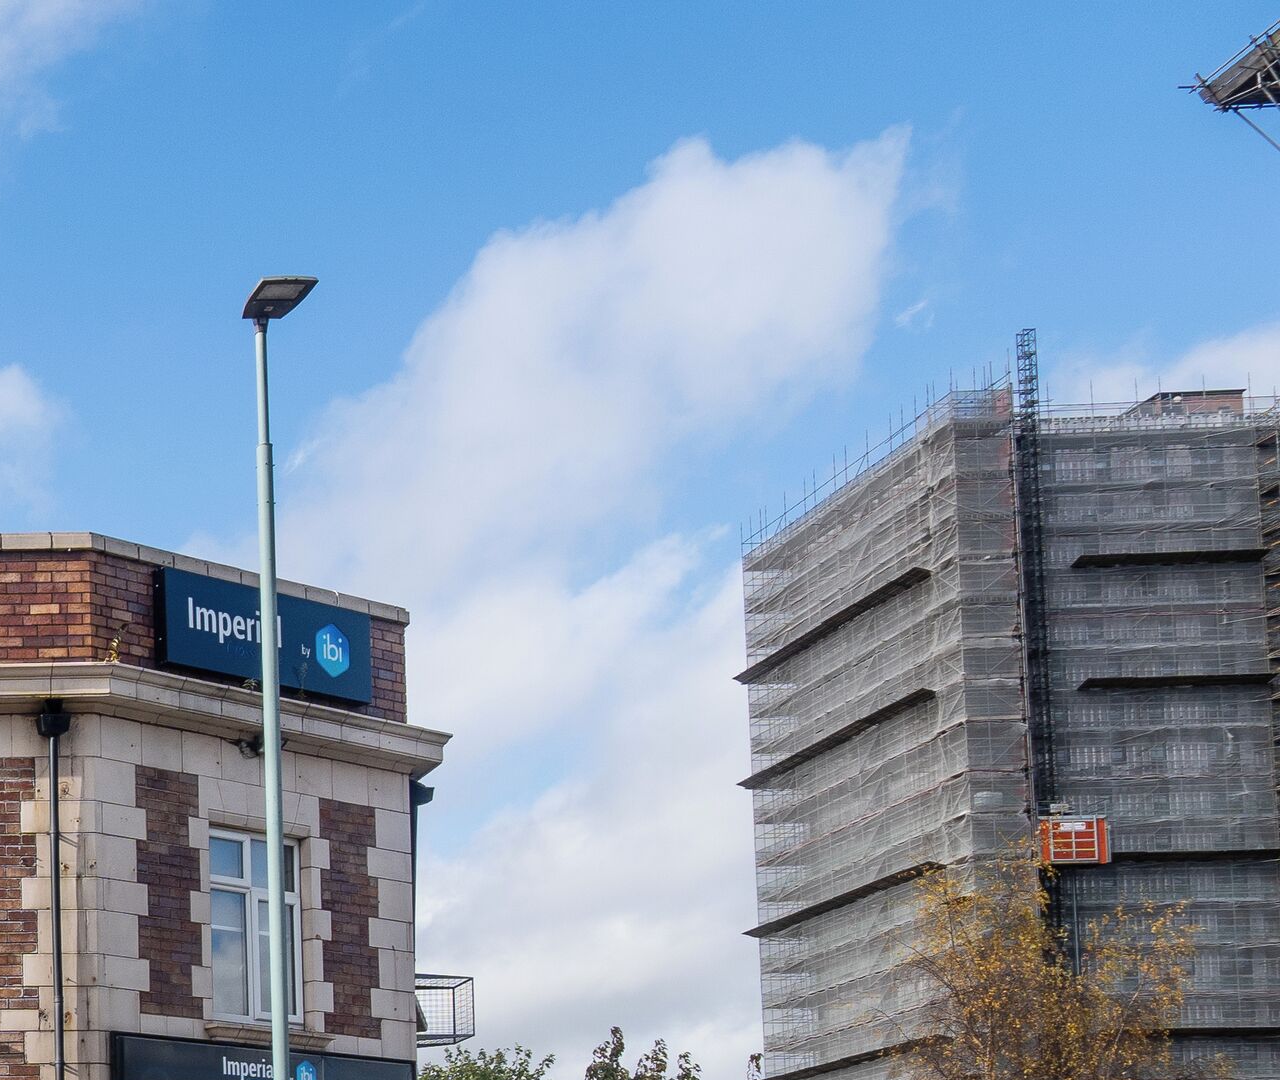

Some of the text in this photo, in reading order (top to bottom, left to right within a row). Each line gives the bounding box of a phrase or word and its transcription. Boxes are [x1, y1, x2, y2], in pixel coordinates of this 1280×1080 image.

[188, 597, 343, 663] Imperil by ibi
[223, 1056, 273, 1080] Imperia
